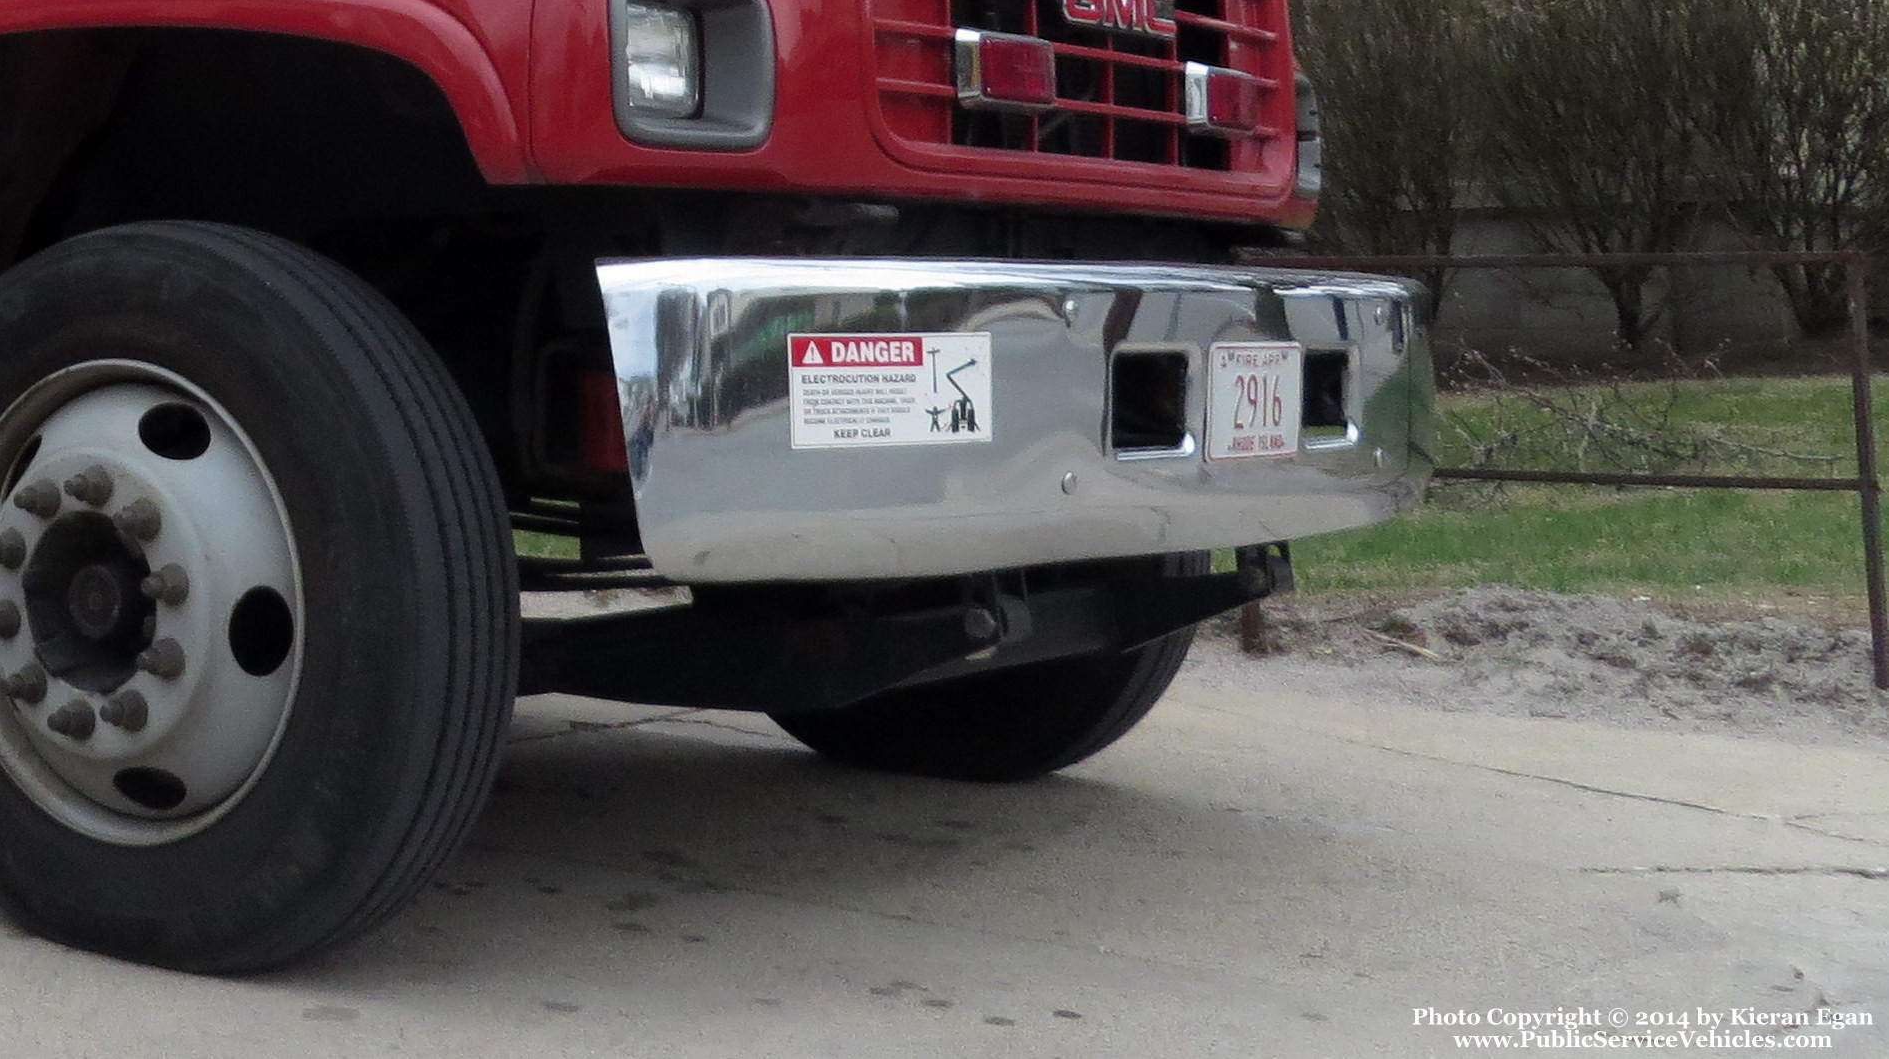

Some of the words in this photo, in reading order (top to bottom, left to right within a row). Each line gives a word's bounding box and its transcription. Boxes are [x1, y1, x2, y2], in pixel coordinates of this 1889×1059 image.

[830, 340, 916, 363] DANGER
[801, 373, 880, 384] ELECTROCUTION
[882, 373, 917, 383] HAZARD
[1233, 373, 1283, 429] 2916
[833, 428, 859, 439] KEEP
[860, 427, 891, 438] CLEAR
